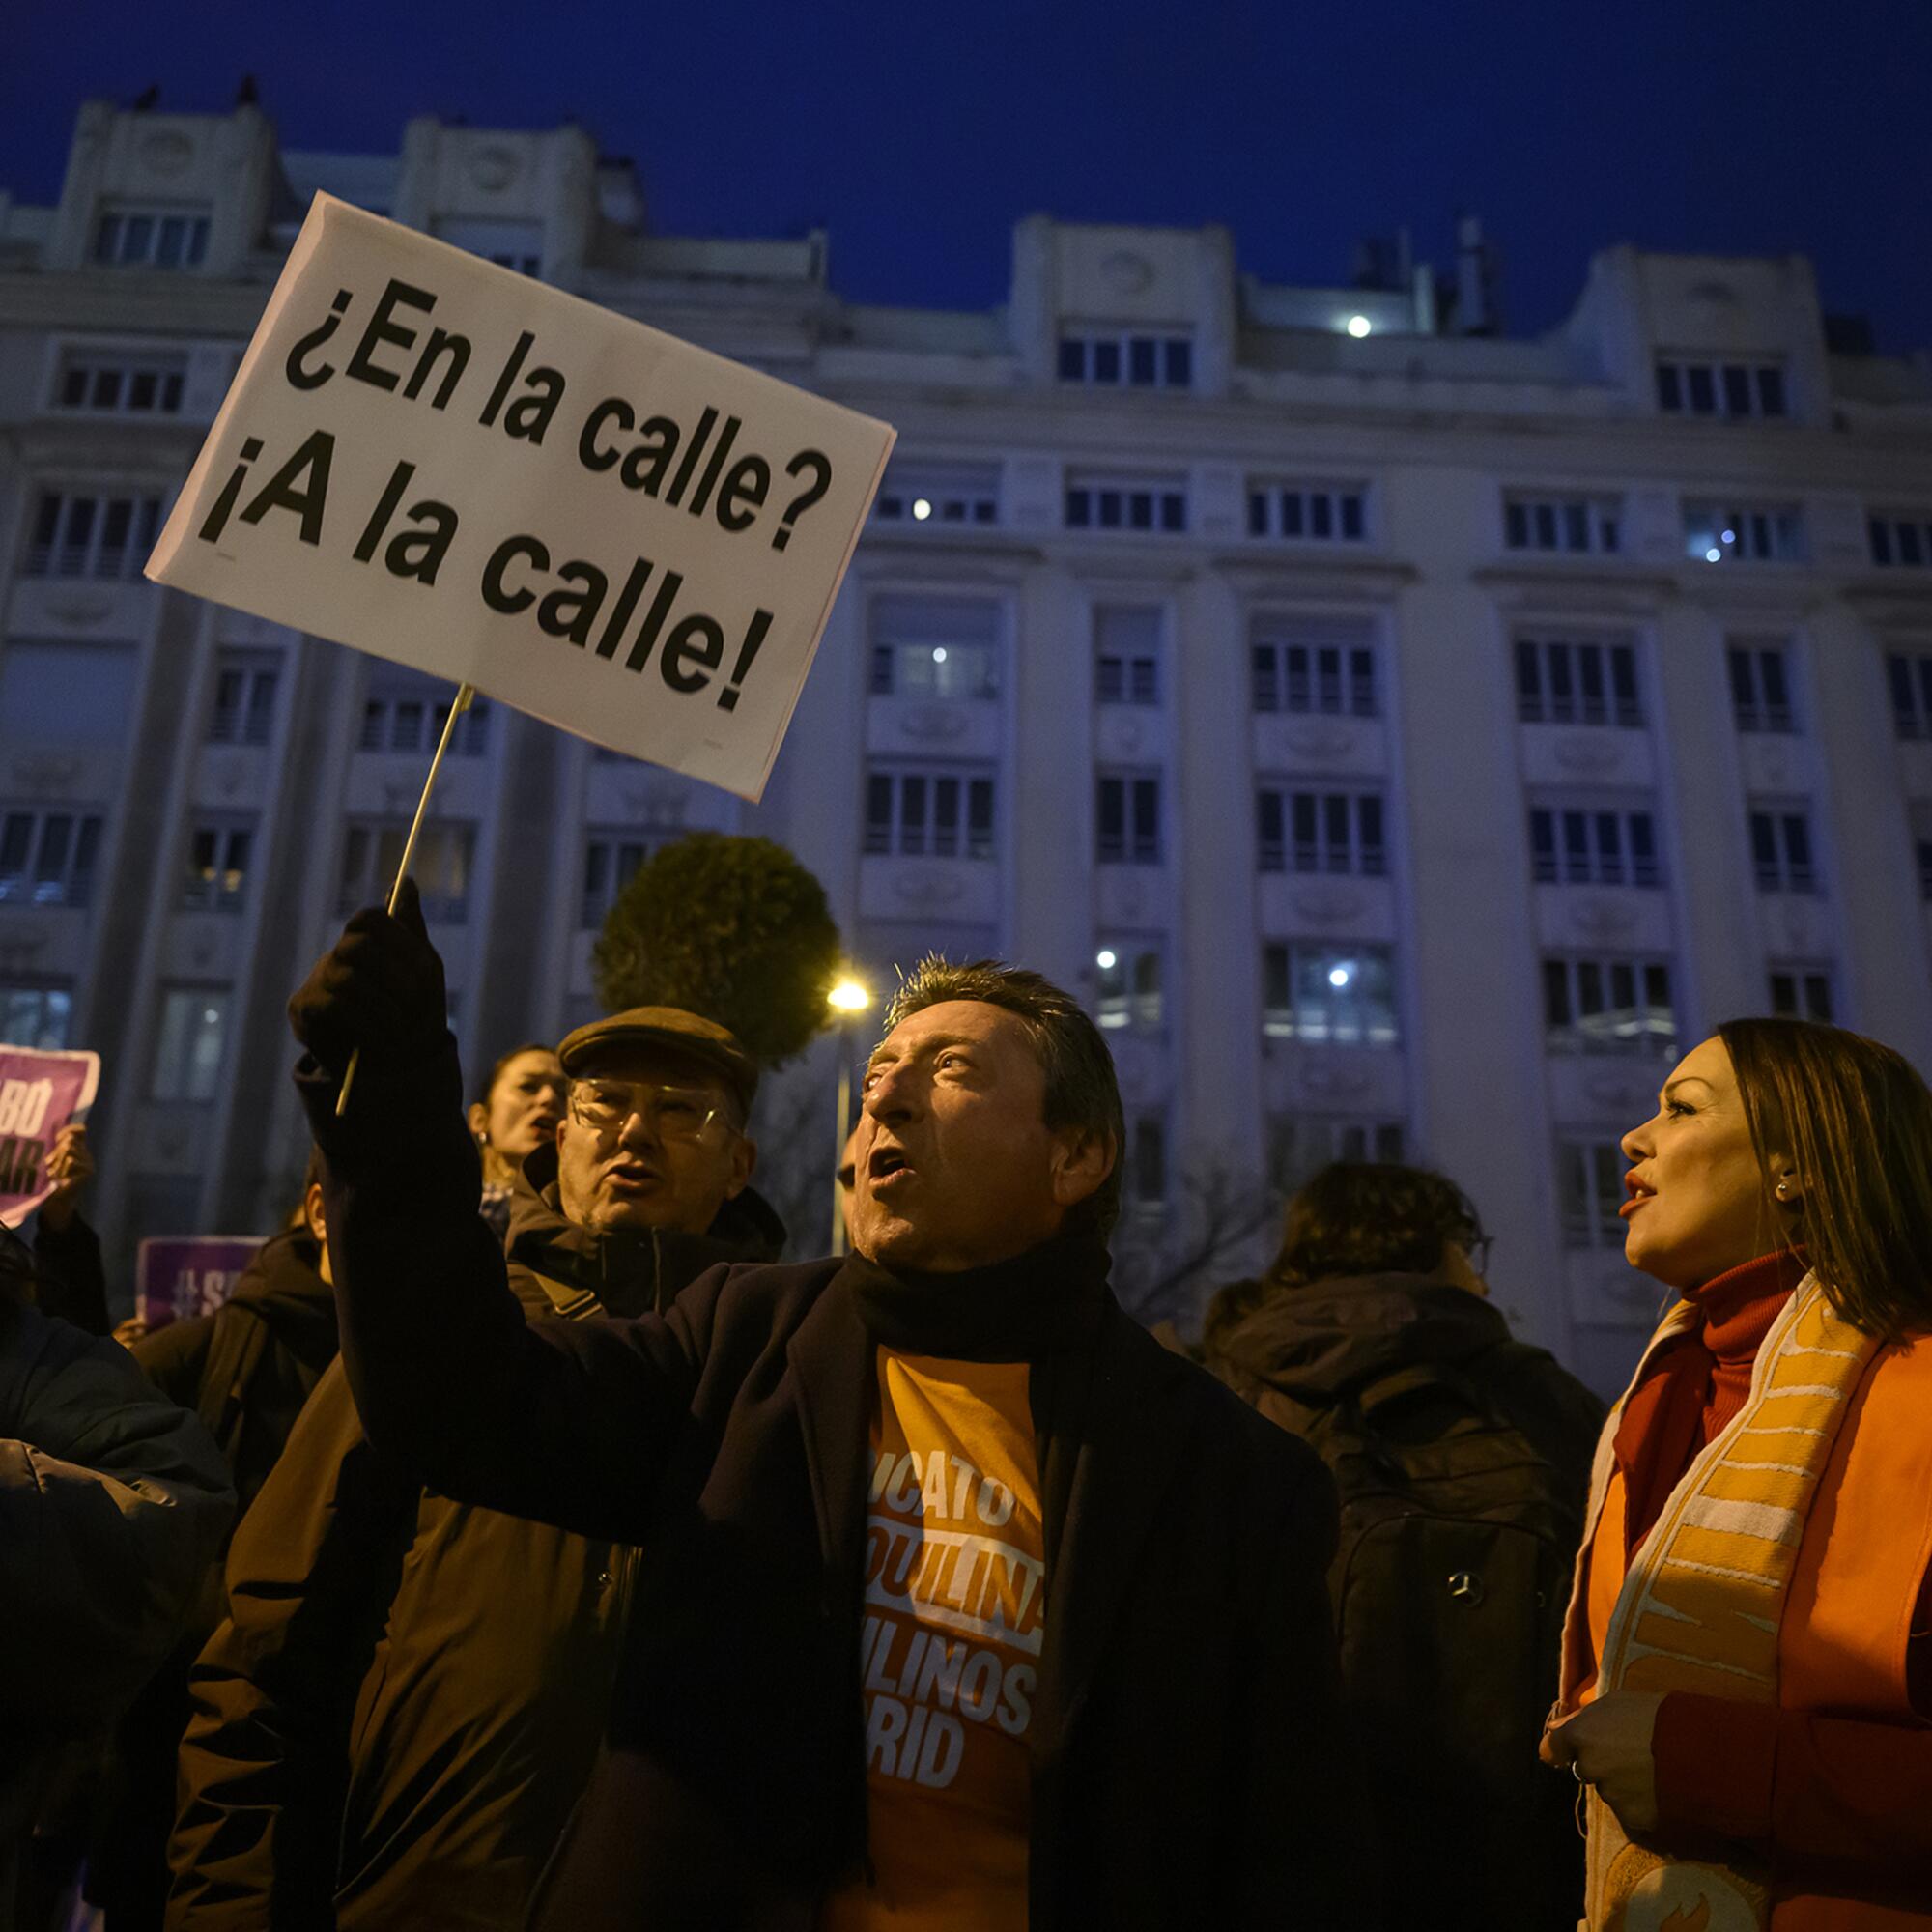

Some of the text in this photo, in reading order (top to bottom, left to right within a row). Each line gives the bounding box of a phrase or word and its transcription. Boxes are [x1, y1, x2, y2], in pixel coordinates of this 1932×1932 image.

[285, 278, 832, 551] ¿En la calle?
[198, 428, 773, 712] ¡A la calle!
[868, 1448, 1016, 1526] ICATO
